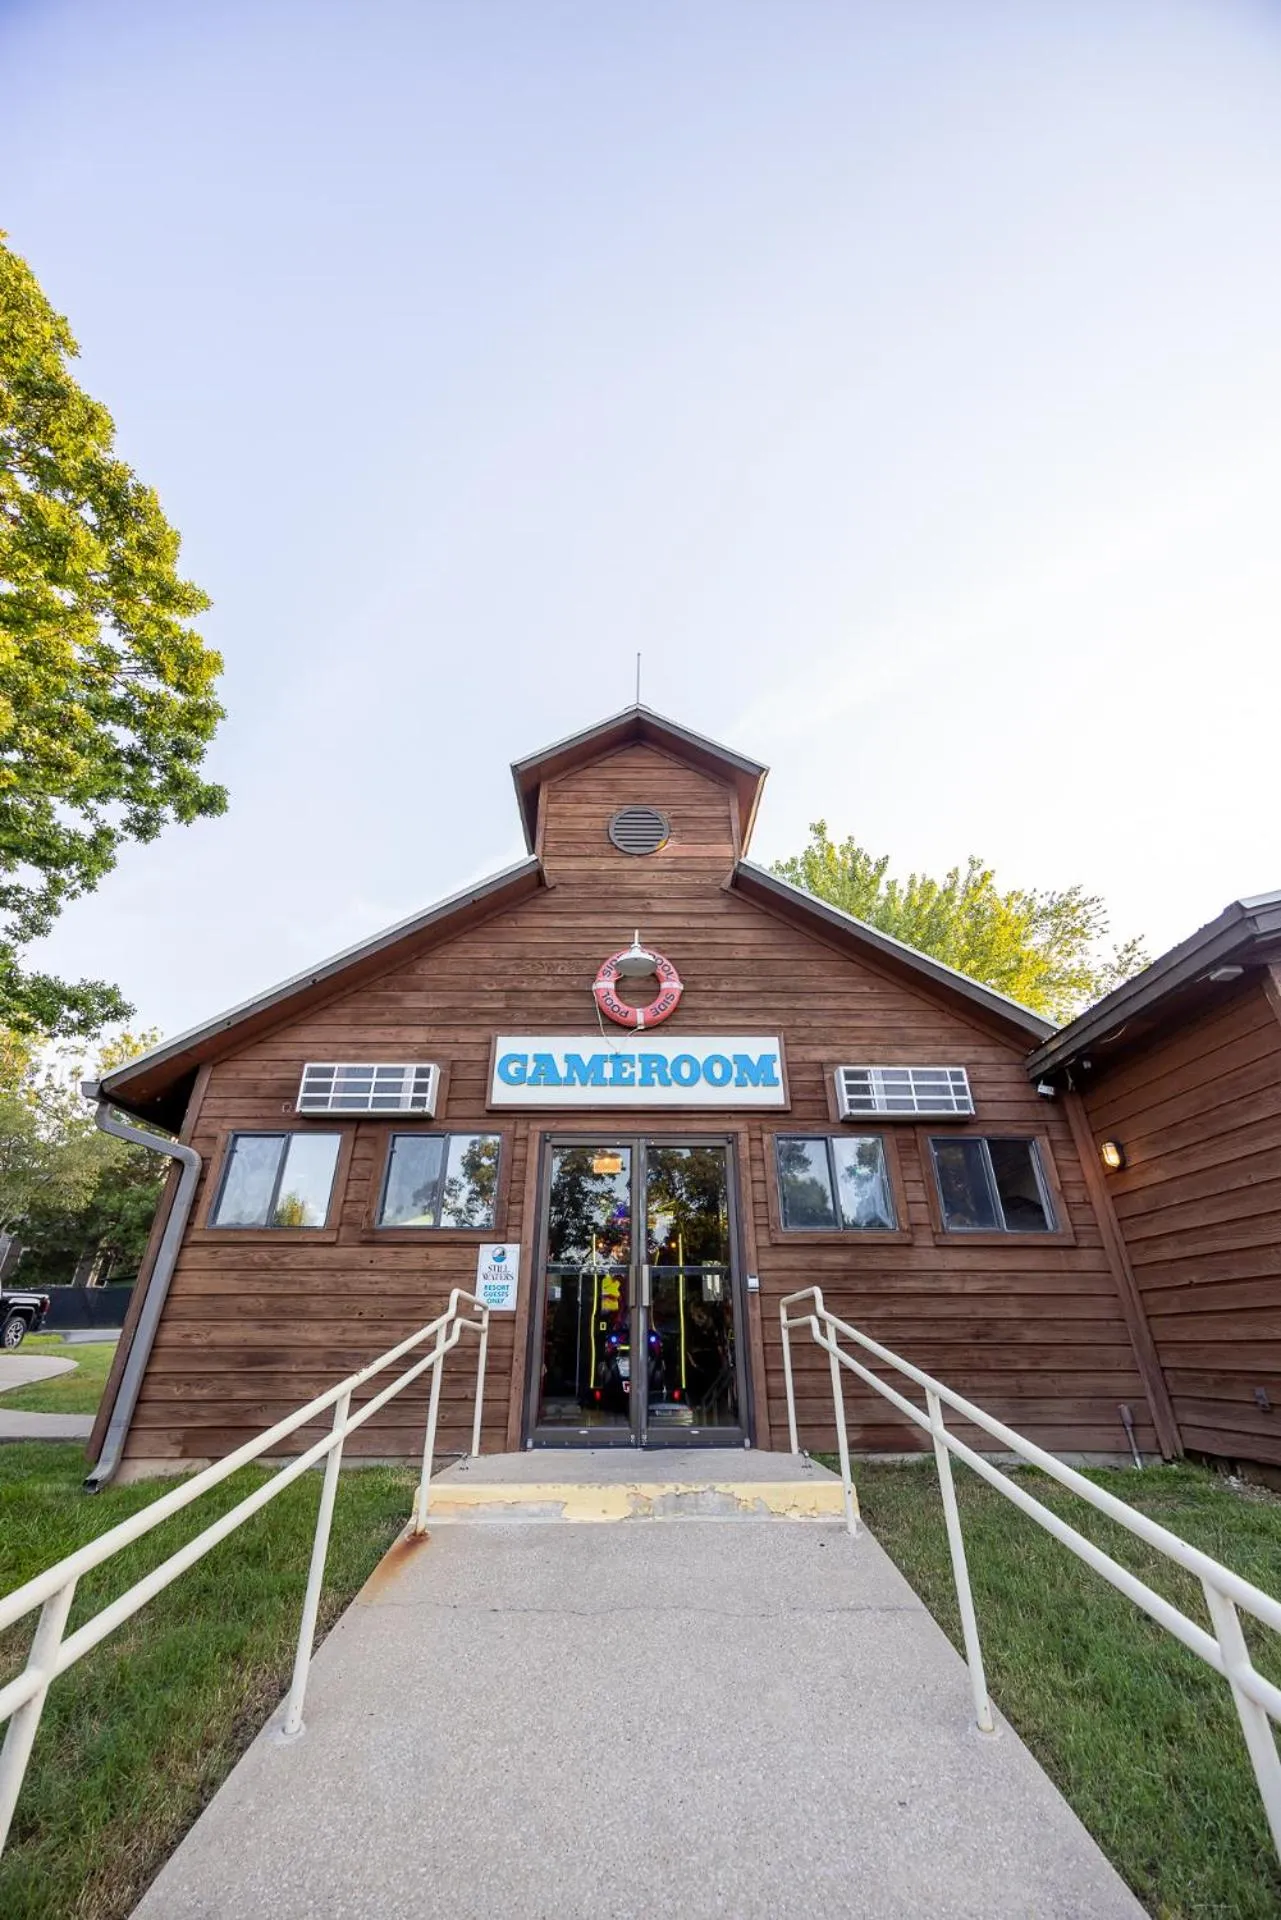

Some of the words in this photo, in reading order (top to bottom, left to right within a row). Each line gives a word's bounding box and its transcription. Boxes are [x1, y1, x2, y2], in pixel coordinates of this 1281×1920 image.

[602, 991, 629, 1018] POOL
[650, 992, 675, 1017] SIDE
[497, 1052, 780, 1087] GAMEROOM
